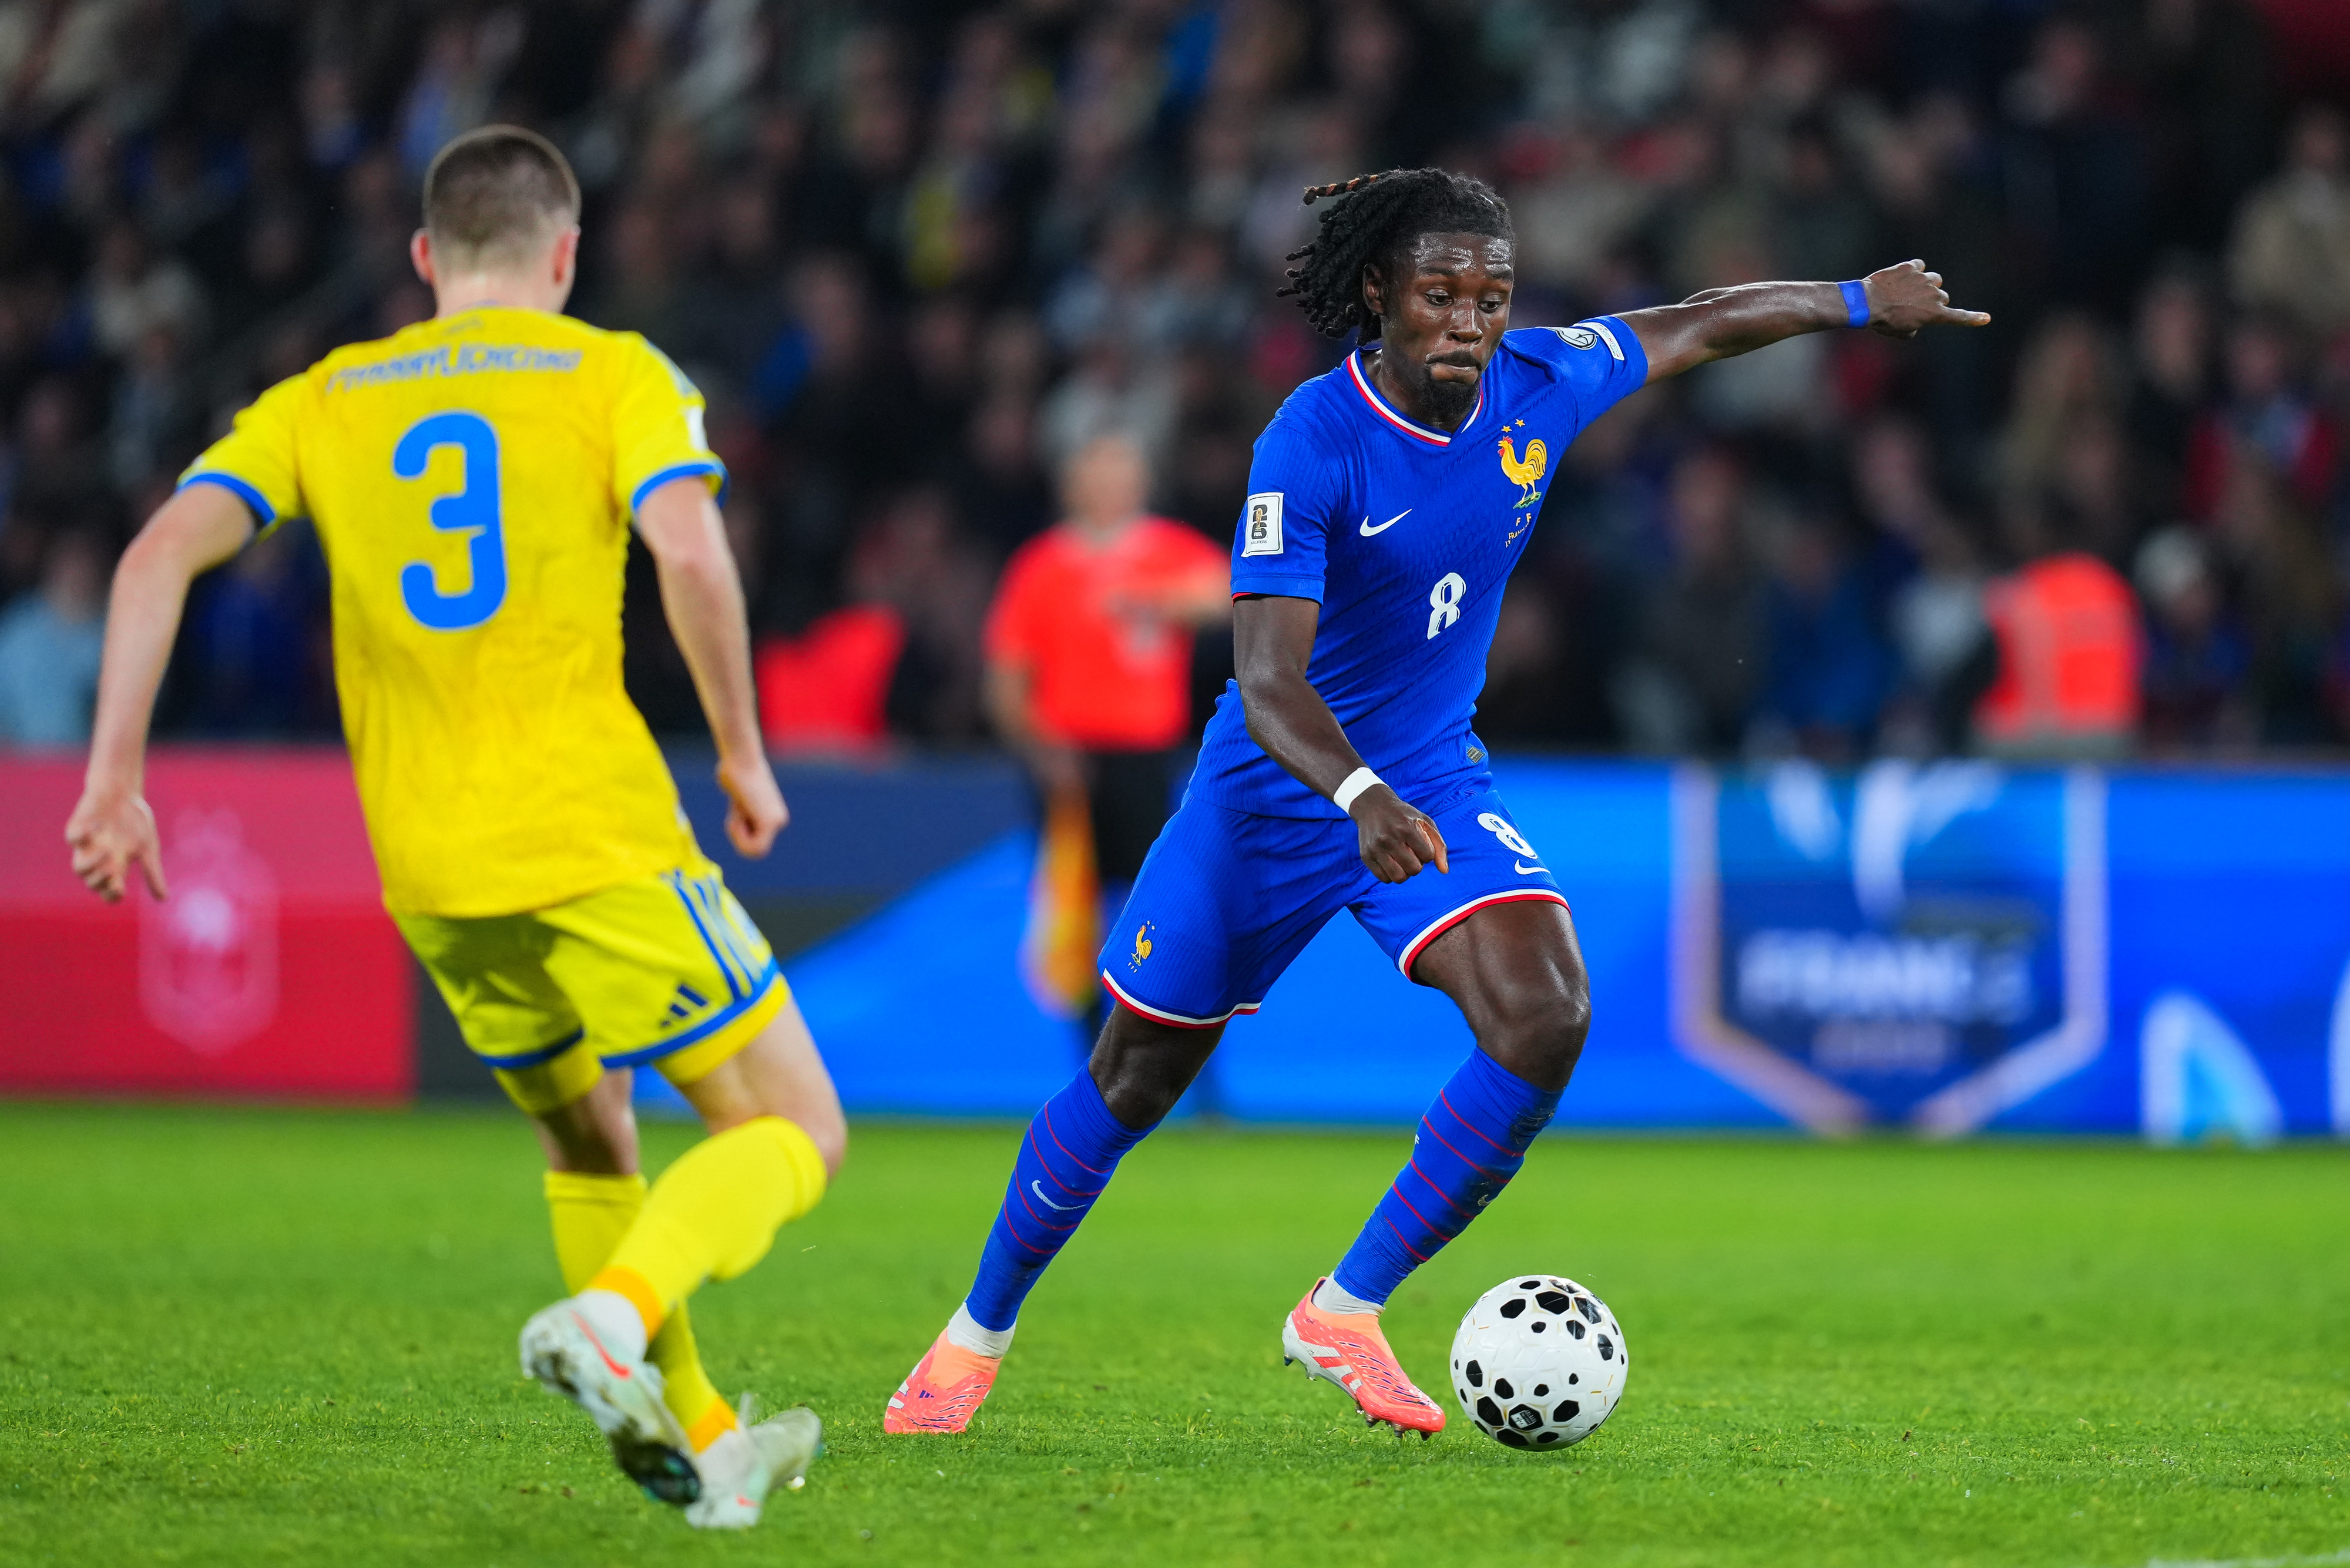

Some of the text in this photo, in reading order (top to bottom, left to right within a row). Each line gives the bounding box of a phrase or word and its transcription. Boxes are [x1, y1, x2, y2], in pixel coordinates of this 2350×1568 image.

[392, 410, 507, 631] 3
[1427, 572, 1466, 640] 8
[1477, 812, 1538, 859] 8
